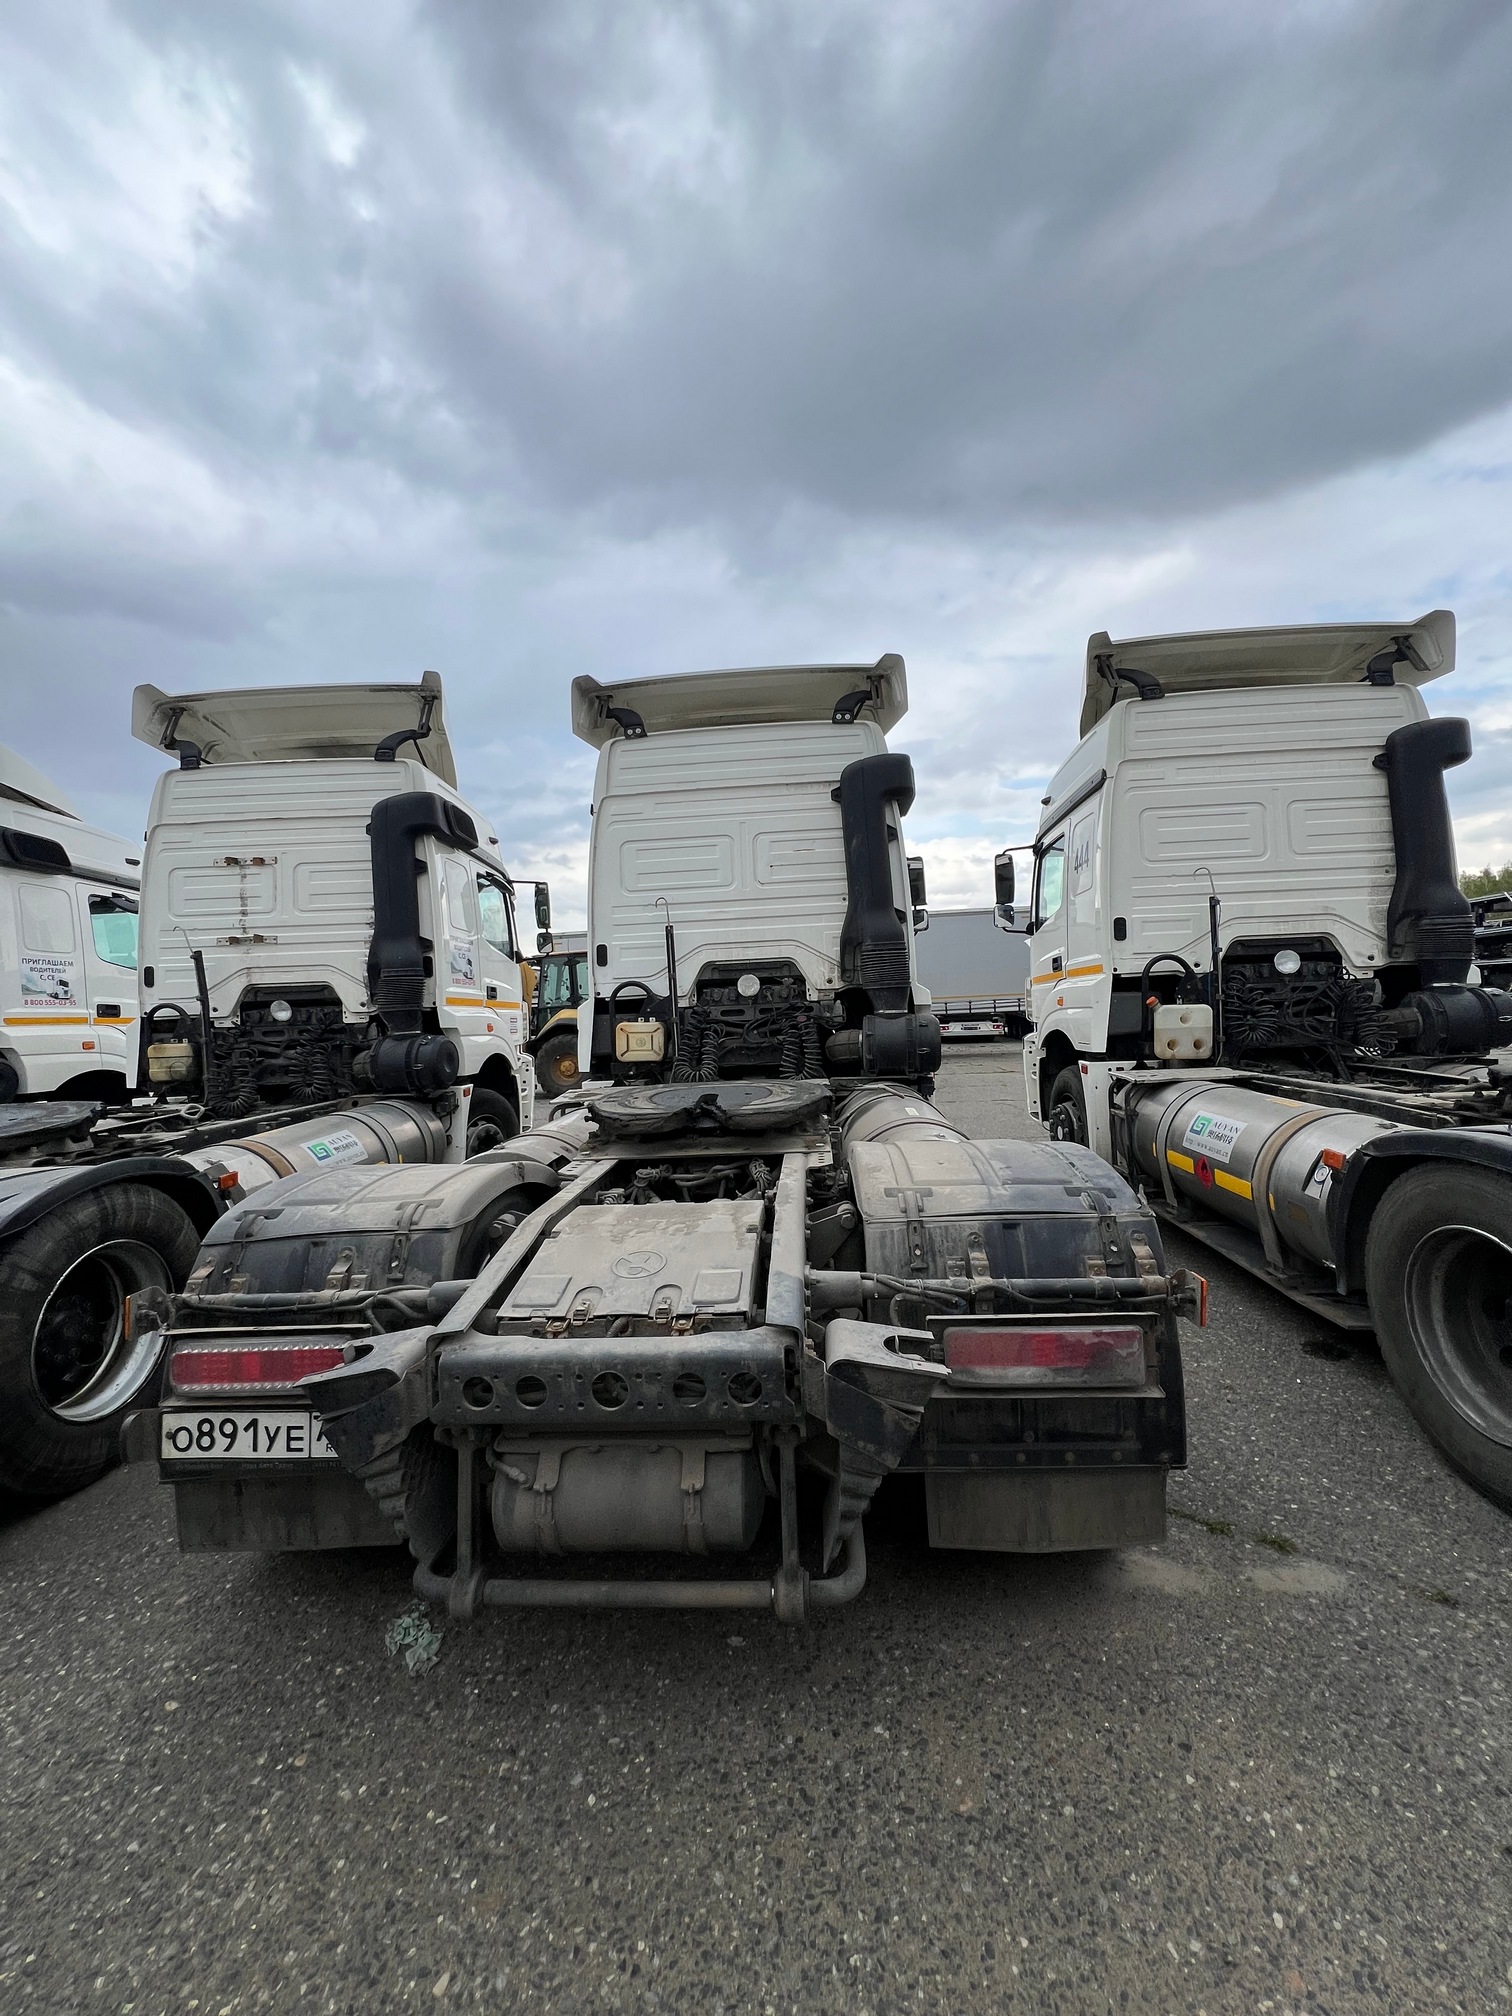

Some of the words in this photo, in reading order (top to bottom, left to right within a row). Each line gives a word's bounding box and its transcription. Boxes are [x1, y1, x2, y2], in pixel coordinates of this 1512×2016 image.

[1074, 840, 1090, 874] 444
[21, 957, 74, 967] ПРИГЛАШАЕМ
[29, 966, 67, 974] ВОДИТЕЛЕЙ
[1213, 1121, 1241, 1134] AUYAN
